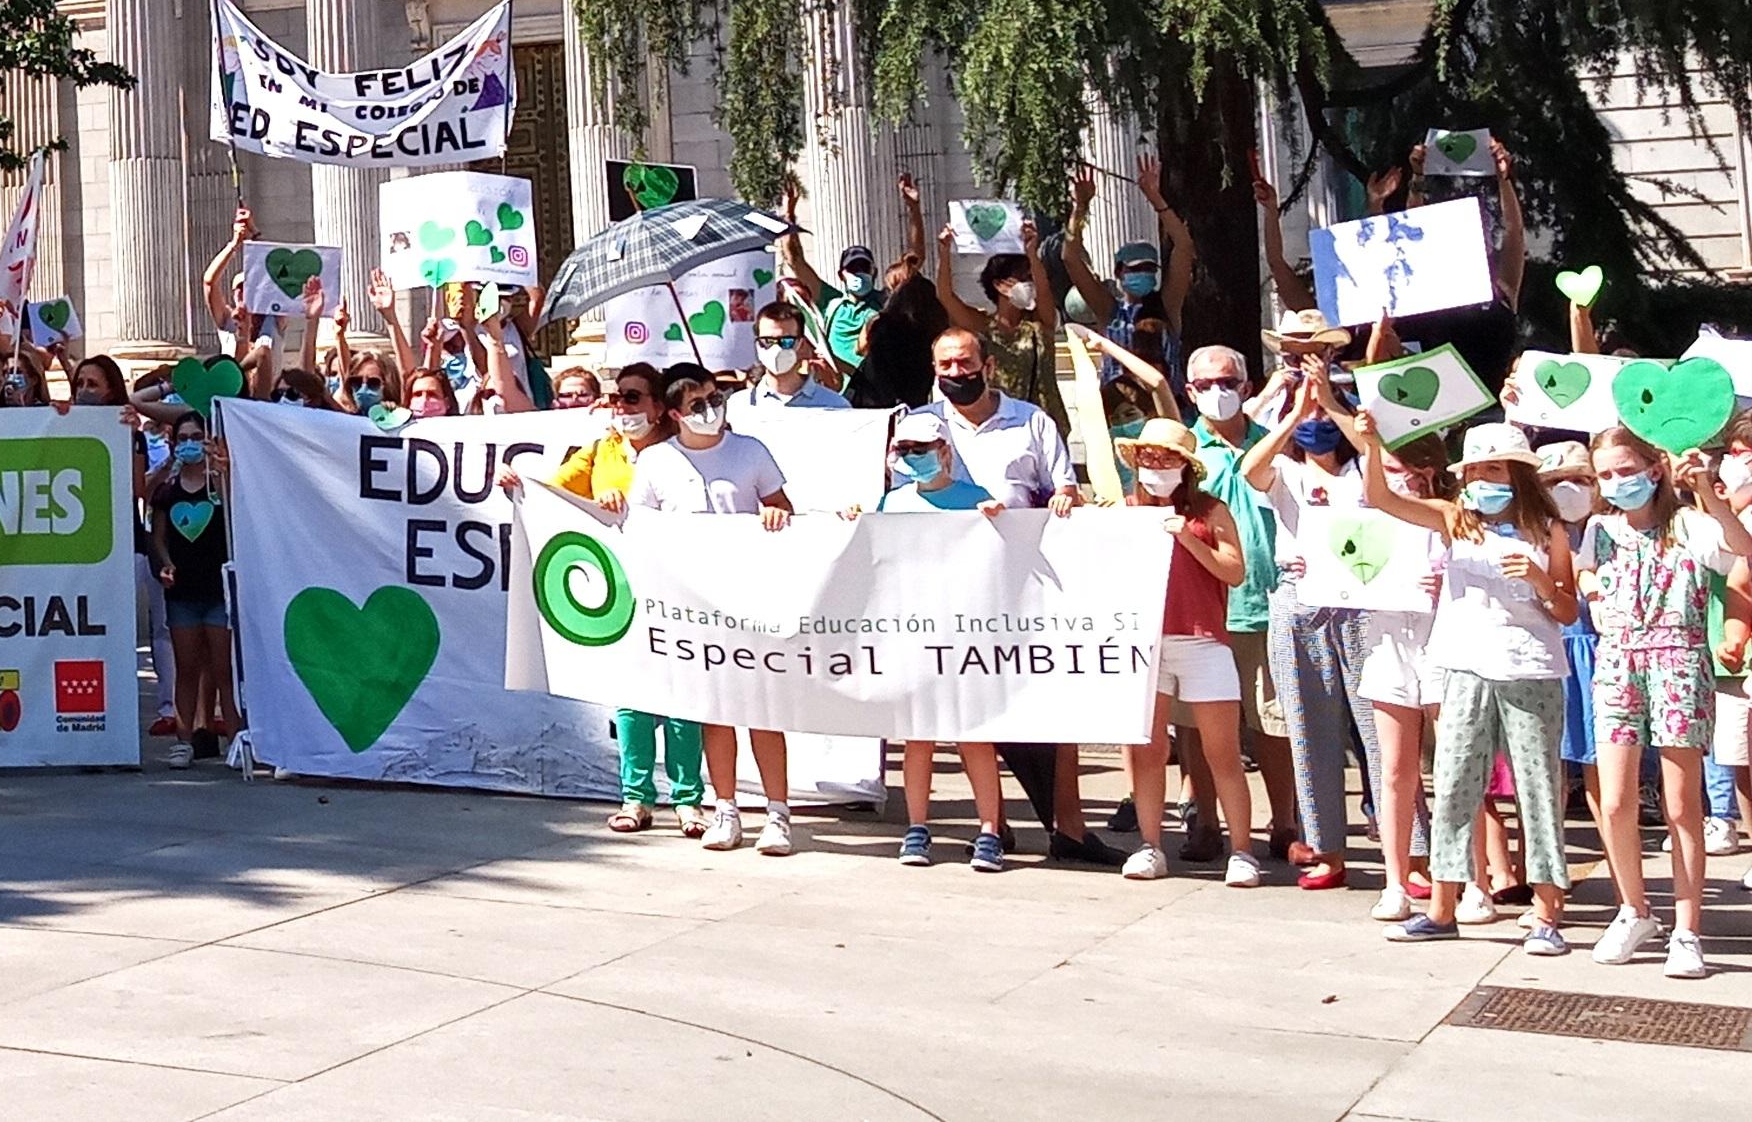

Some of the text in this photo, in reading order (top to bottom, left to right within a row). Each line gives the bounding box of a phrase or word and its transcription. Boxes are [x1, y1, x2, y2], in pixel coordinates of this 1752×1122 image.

[252, 39, 469, 97] SOY FELIZ
[258, 74, 283, 94] EN
[299, 94, 328, 114] MI
[453, 77, 480, 96] DE
[230, 101, 486, 159] ED. ESPECIAL
[799, 614, 935, 634] Educación
[954, 613, 1094, 633] Inclusiva
[648, 626, 1153, 676] Especial TAMBIÉN
[56, 715, 106, 723] Comunidad
[56, 722, 106, 732] de Madrid
